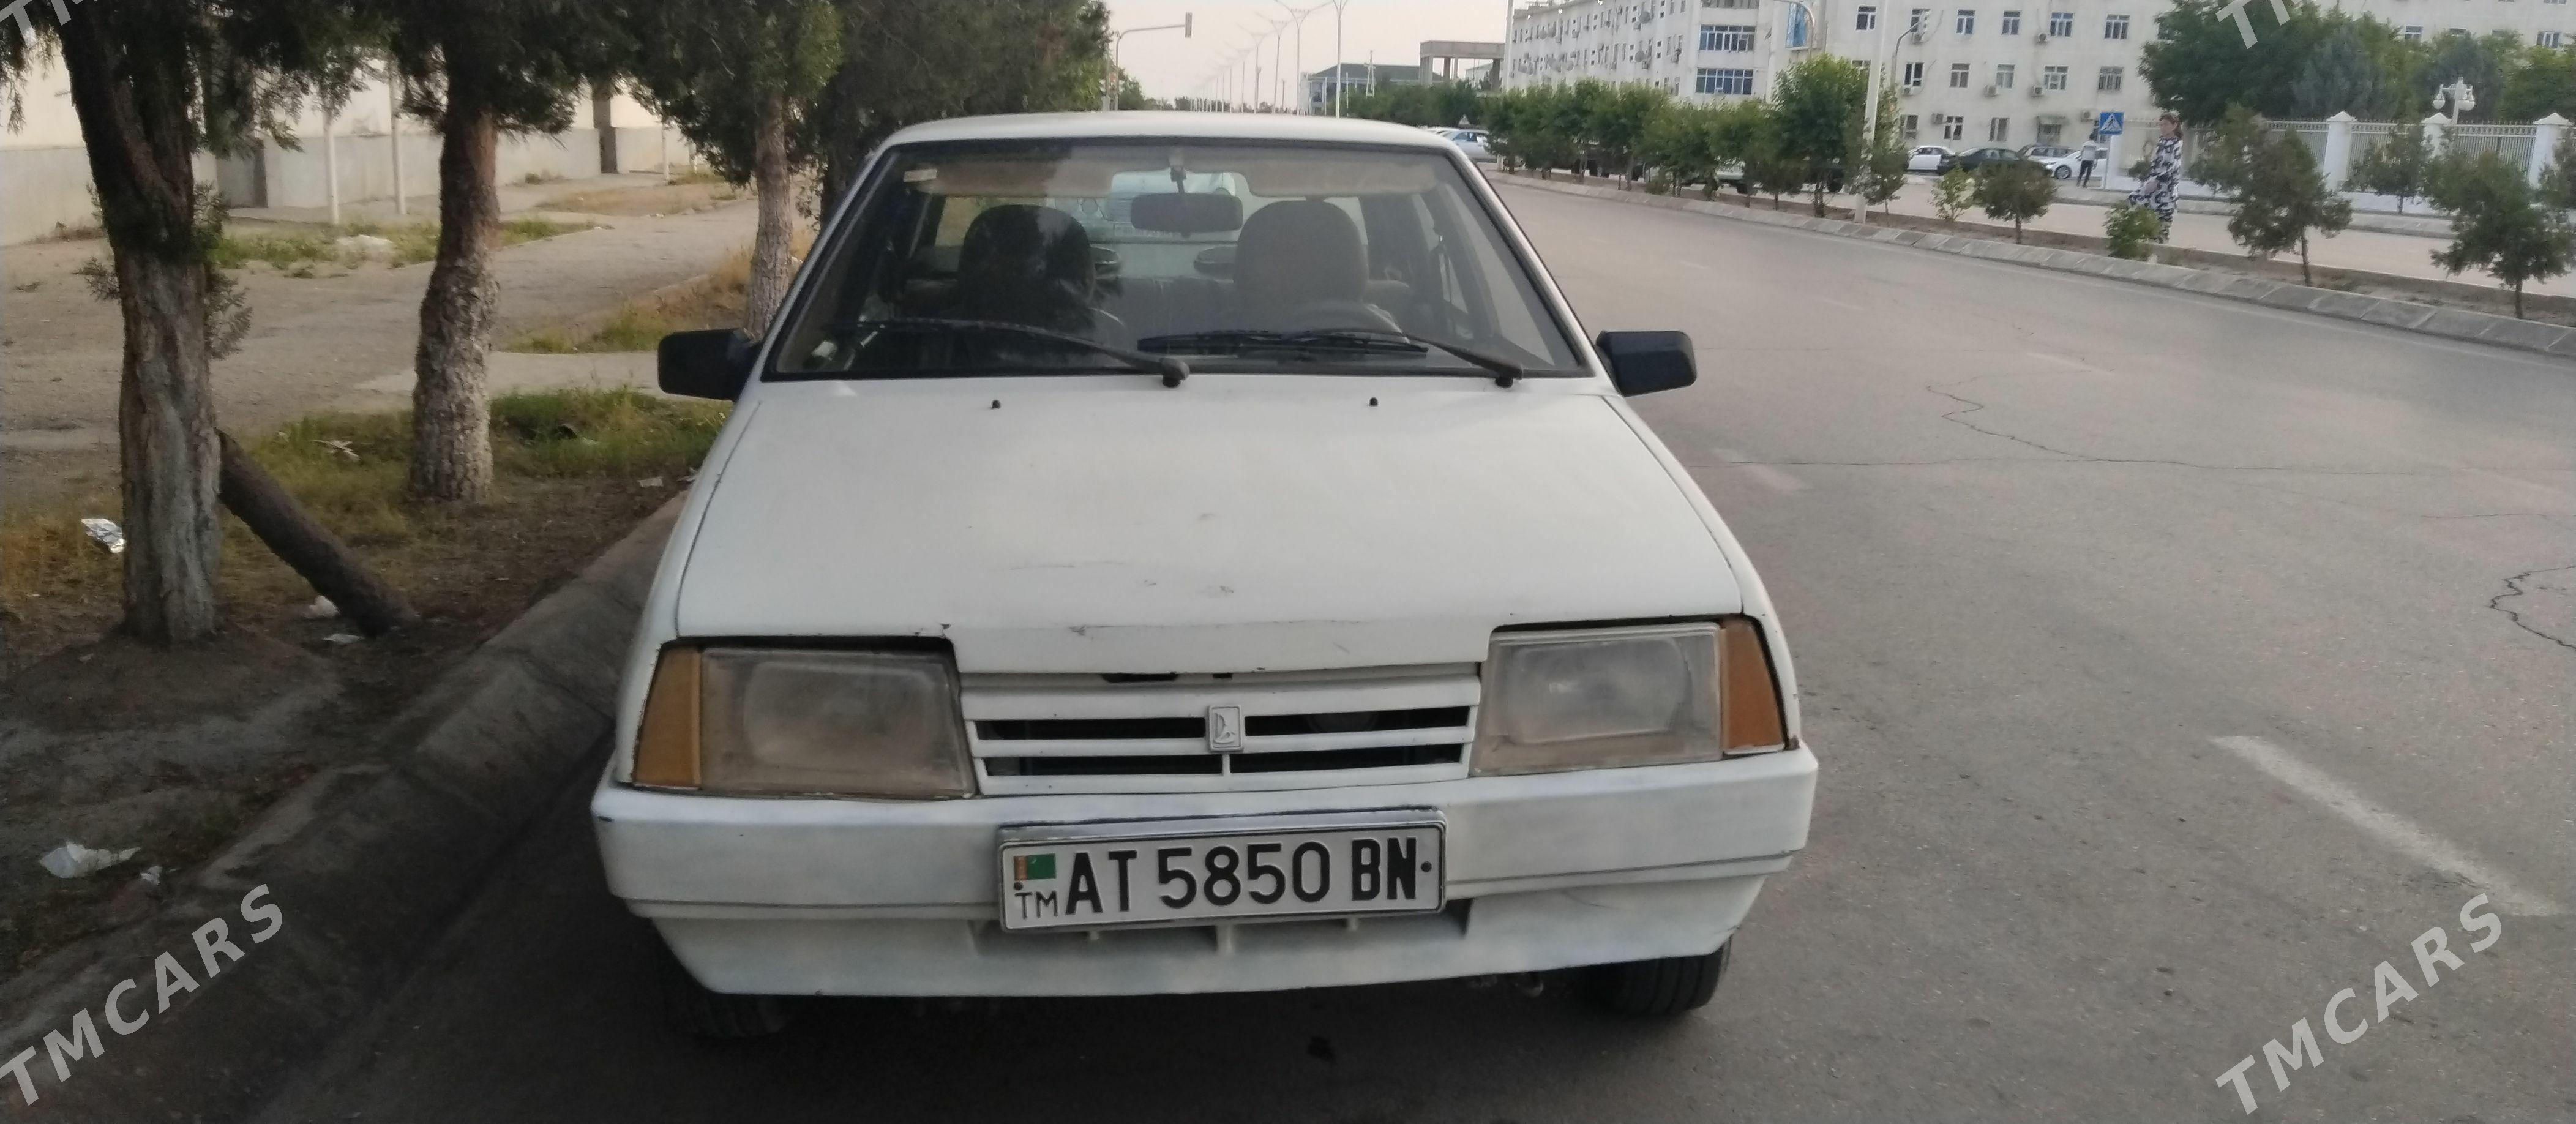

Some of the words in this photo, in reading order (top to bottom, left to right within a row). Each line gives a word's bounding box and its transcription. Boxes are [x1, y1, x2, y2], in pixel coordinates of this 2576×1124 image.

[1065, 850, 1137, 915] AT
[1158, 841, 1330, 909] 5850
[1351, 837, 1417, 901] BN
[1014, 891, 1058, 919] TM
